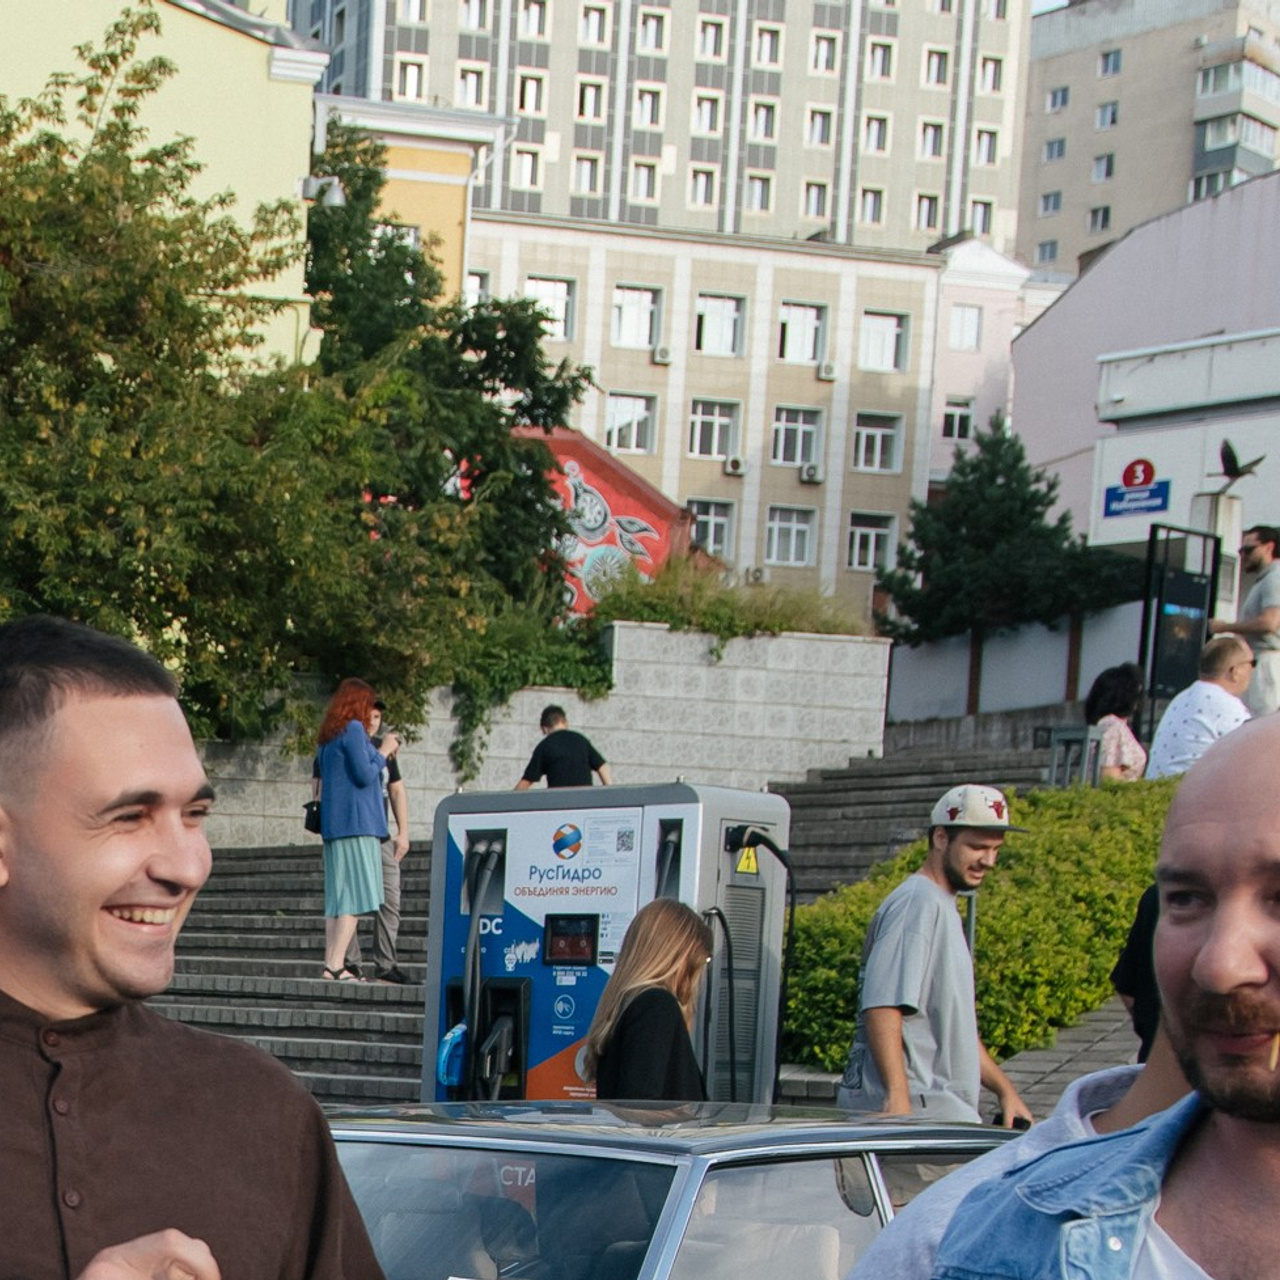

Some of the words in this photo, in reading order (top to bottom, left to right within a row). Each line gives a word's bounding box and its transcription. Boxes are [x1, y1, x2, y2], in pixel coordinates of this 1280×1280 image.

[1132, 463, 1145, 485] 3
[529, 865, 602, 884] РусГидро
[513, 886, 570, 897] ОБЪЕДИНЯЯ
[571, 886, 618, 897] ЭНЕРГИЮ
[479, 918, 503, 935] DC
